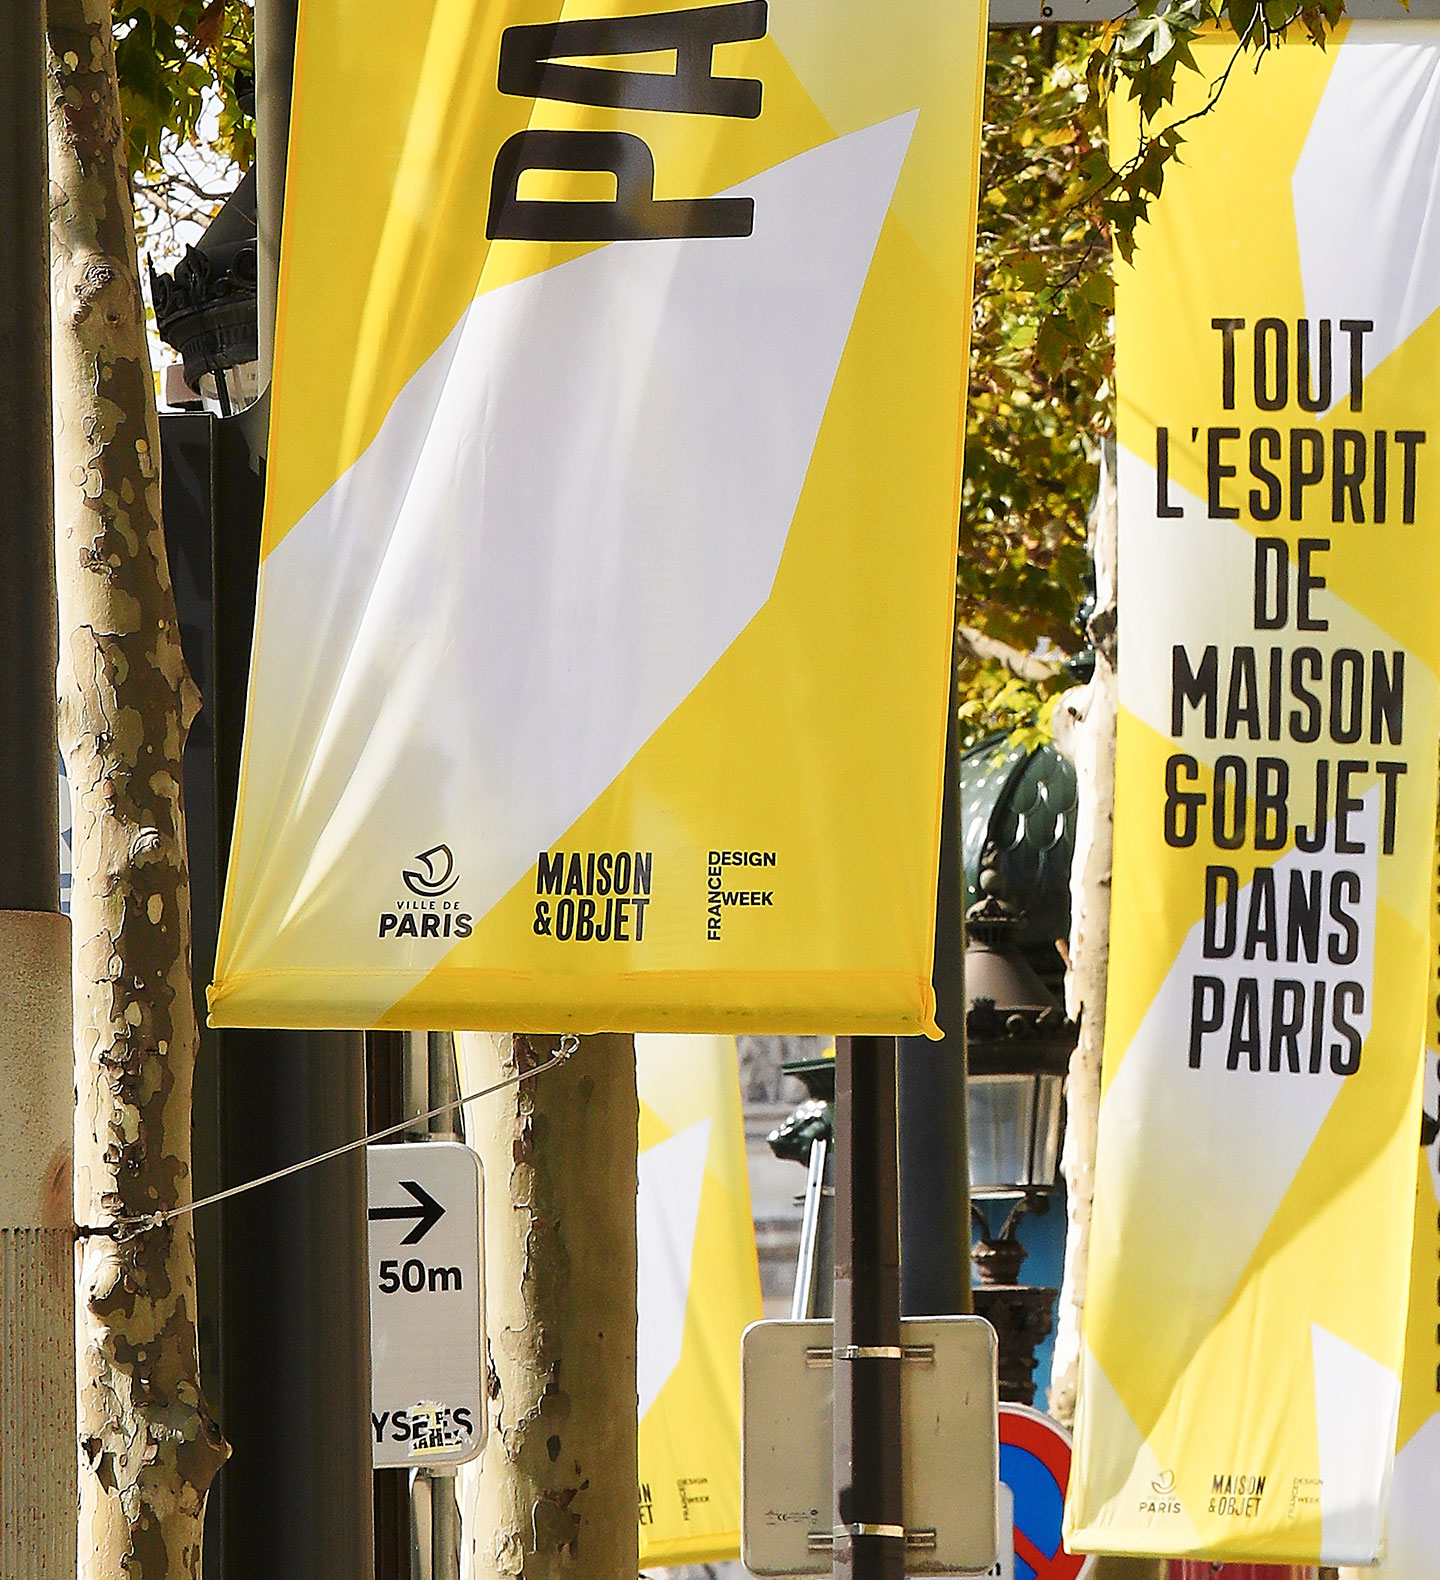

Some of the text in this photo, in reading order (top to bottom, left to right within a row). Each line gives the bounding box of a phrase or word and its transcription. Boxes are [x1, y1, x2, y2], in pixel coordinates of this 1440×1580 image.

[1211, 317, 1374, 412] TOUT
[1156, 427, 1426, 525] L'ESPRIT
[1254, 537, 1331, 632] DE
[1171, 644, 1405, 745] MAISON
[1163, 754, 1408, 856] &OBJET
[536, 852, 652, 896] MAISON
[708, 851, 777, 867] DESIGN
[396, 901, 460, 910] VILLE DE
[533, 898, 650, 942] &OBJET
[707, 865, 722, 941] FRANCE
[721, 891, 774, 906] WEEK
[1202, 865, 1361, 965] DANS
[378, 913, 474, 938] PARIS
[1188, 974, 1364, 1077] PARIS
[378, 1259, 462, 1293] 50m
[1207, 1497, 1262, 1517] &OBJET
[1211, 1475, 1266, 1495] MAISON
[1138, 1502, 1182, 1514] PARIS
